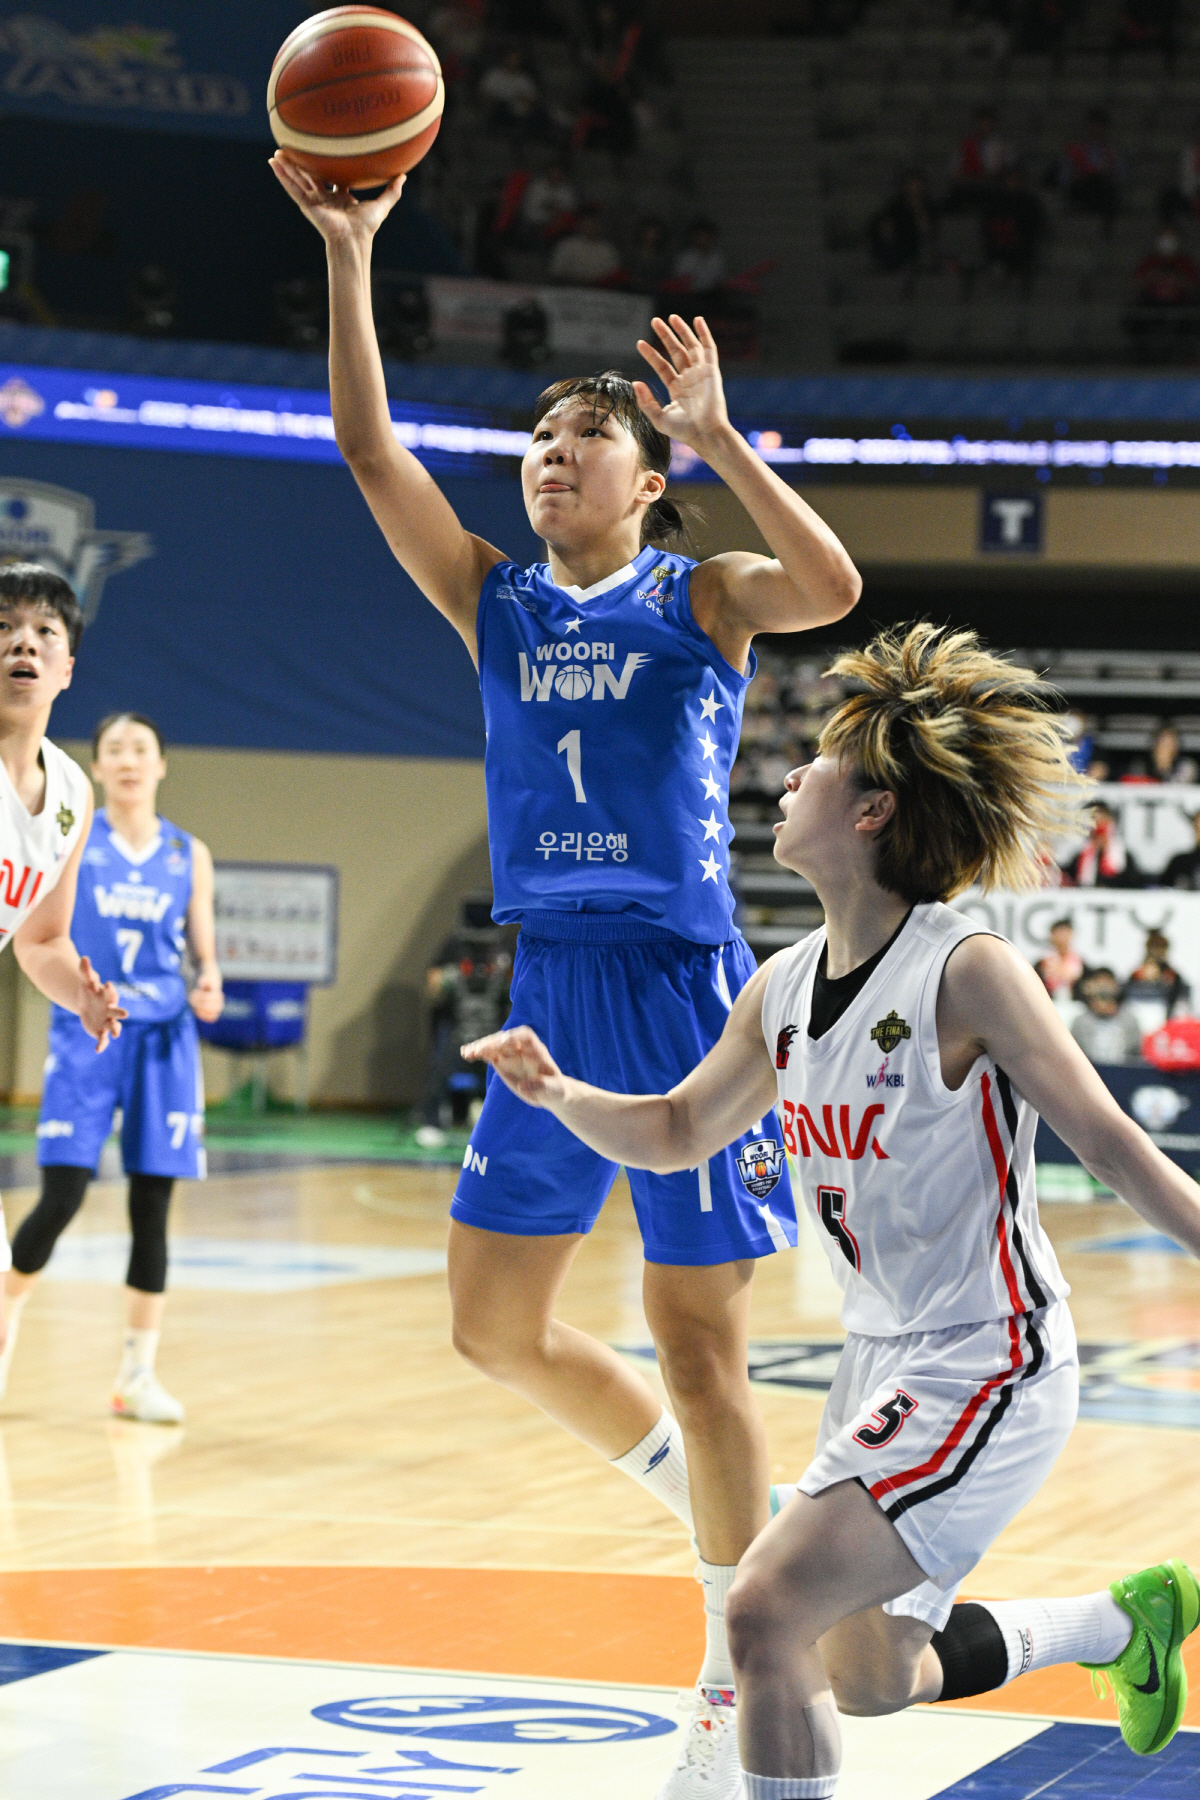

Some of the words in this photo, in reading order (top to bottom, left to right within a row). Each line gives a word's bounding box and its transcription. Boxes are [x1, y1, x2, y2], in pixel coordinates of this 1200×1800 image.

[536, 642, 615, 661] WOORI
[518, 652, 653, 702] WON
[557, 729, 587, 804] 1
[535, 831, 628, 862] 우리은행
[116, 928, 144, 974] 7
[872, 1026, 884, 1039] THE
[885, 1025, 911, 1038] FINALS
[866, 1074, 905, 1088] WKBL
[166, 1111, 188, 1149] 7
[783, 1099, 890, 1160] BNK
[738, 1150, 785, 1182] WON
[749, 1151, 769, 1161] WOORI
[852, 1389, 919, 1450] 5
